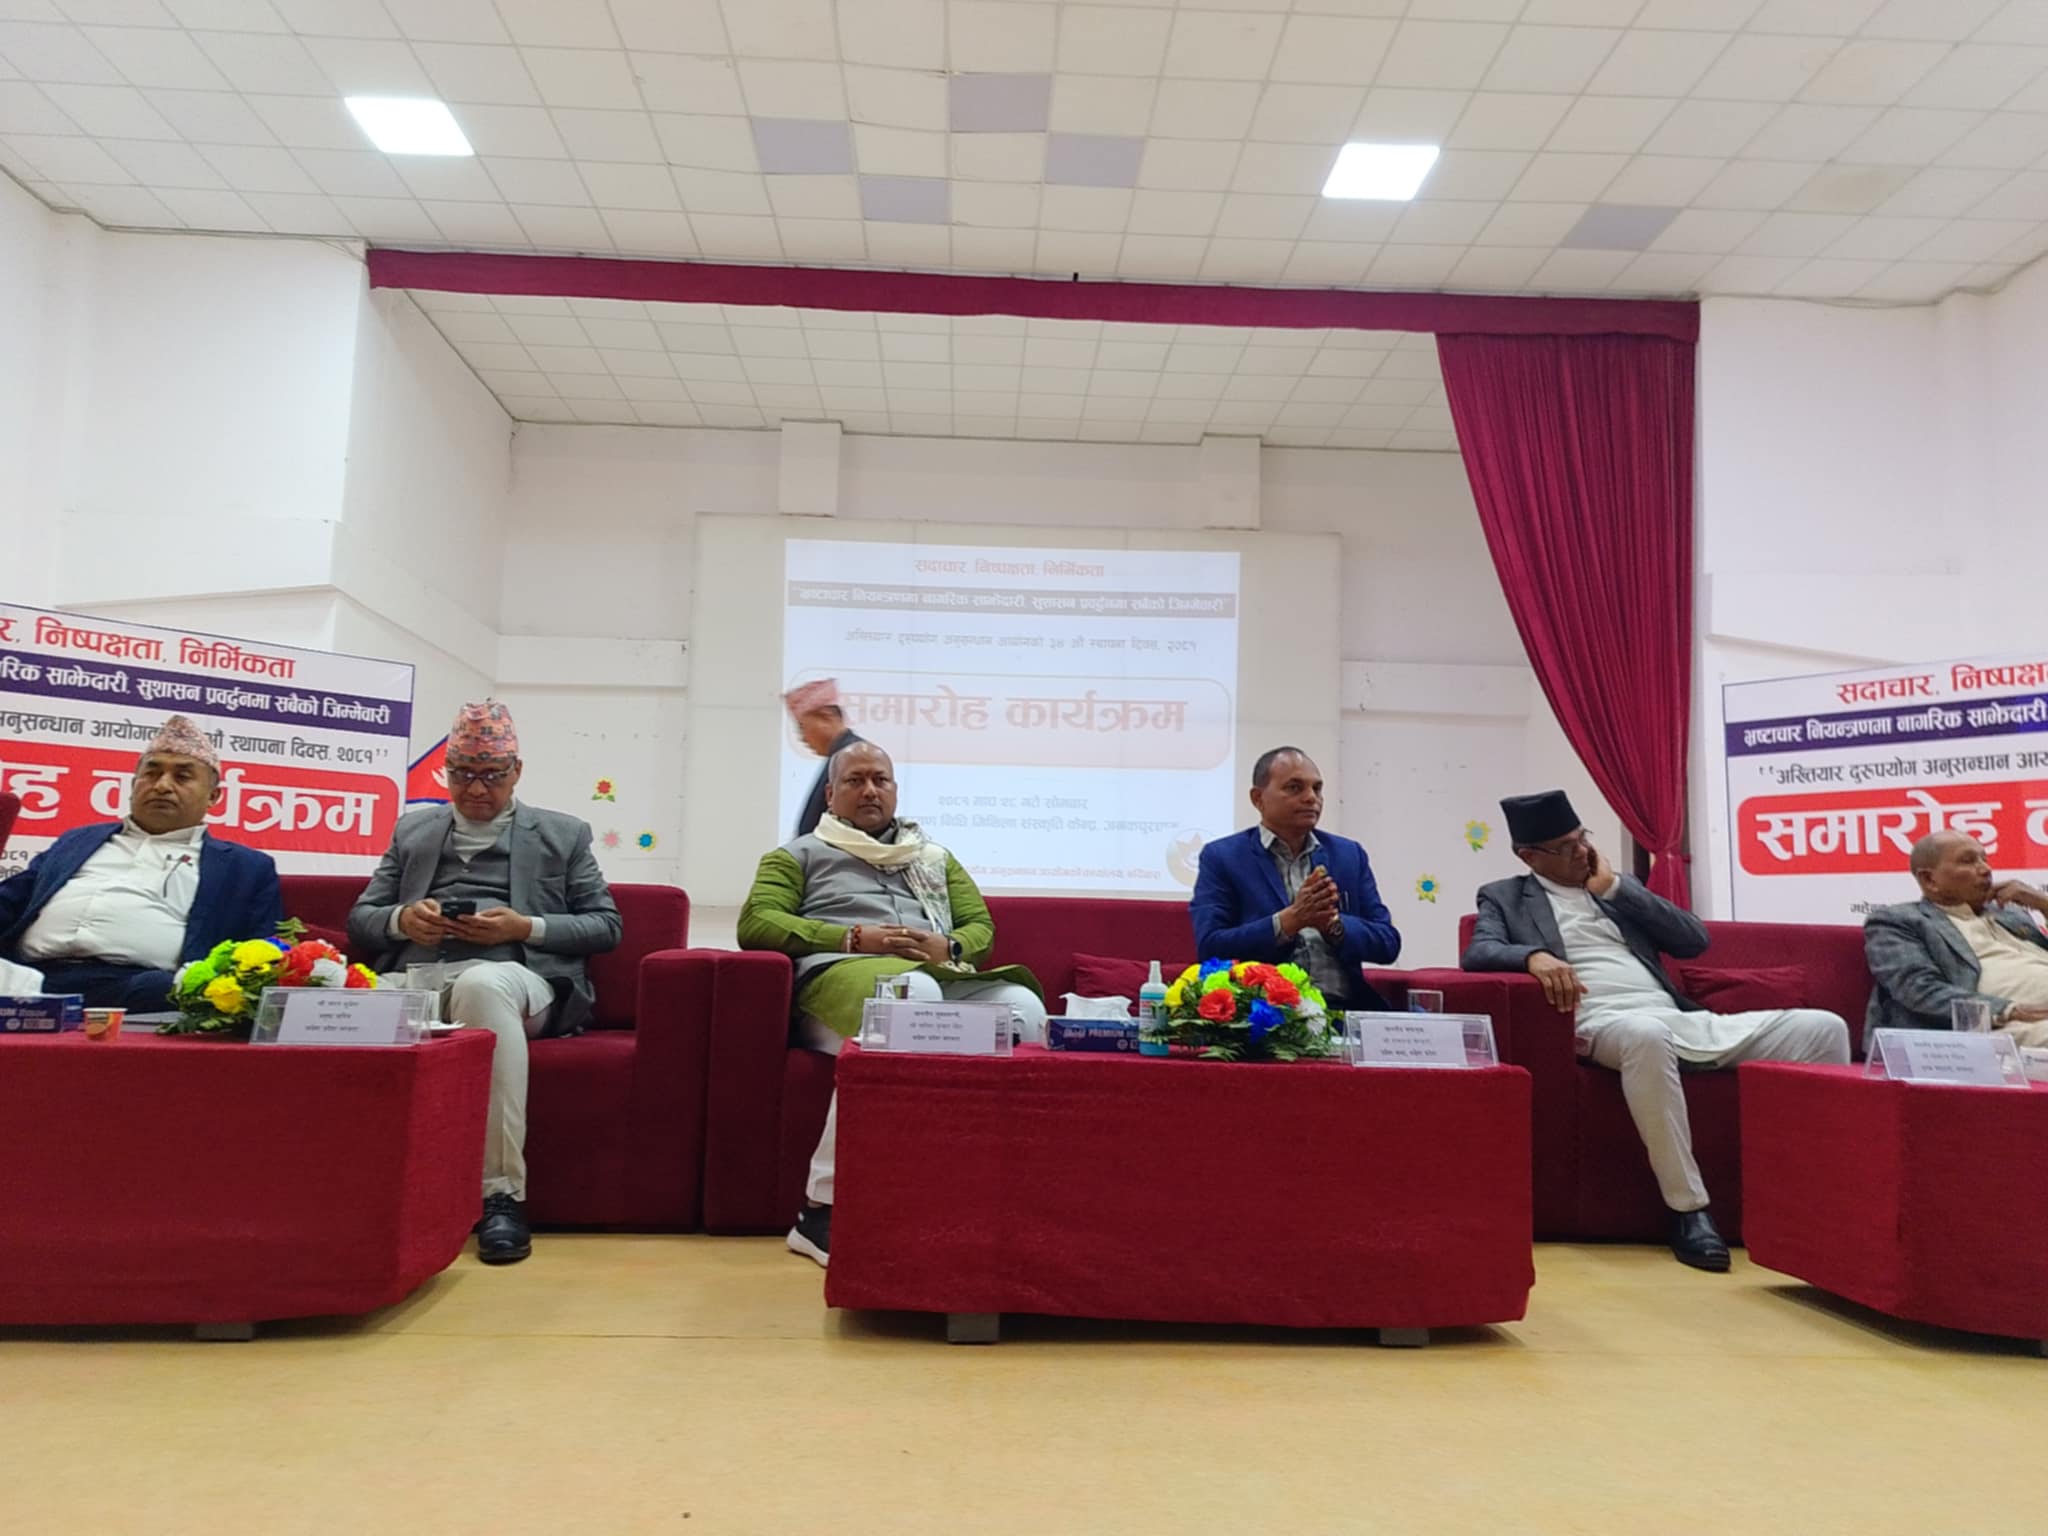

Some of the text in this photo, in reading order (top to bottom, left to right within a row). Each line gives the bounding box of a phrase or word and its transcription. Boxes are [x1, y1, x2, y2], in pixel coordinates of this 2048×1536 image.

[1951, 662, 2048, 692] निष्पक्ष
[1006, 690, 1189, 732] कार्यक्रम
[1755, 790, 2003, 861] समारोह
